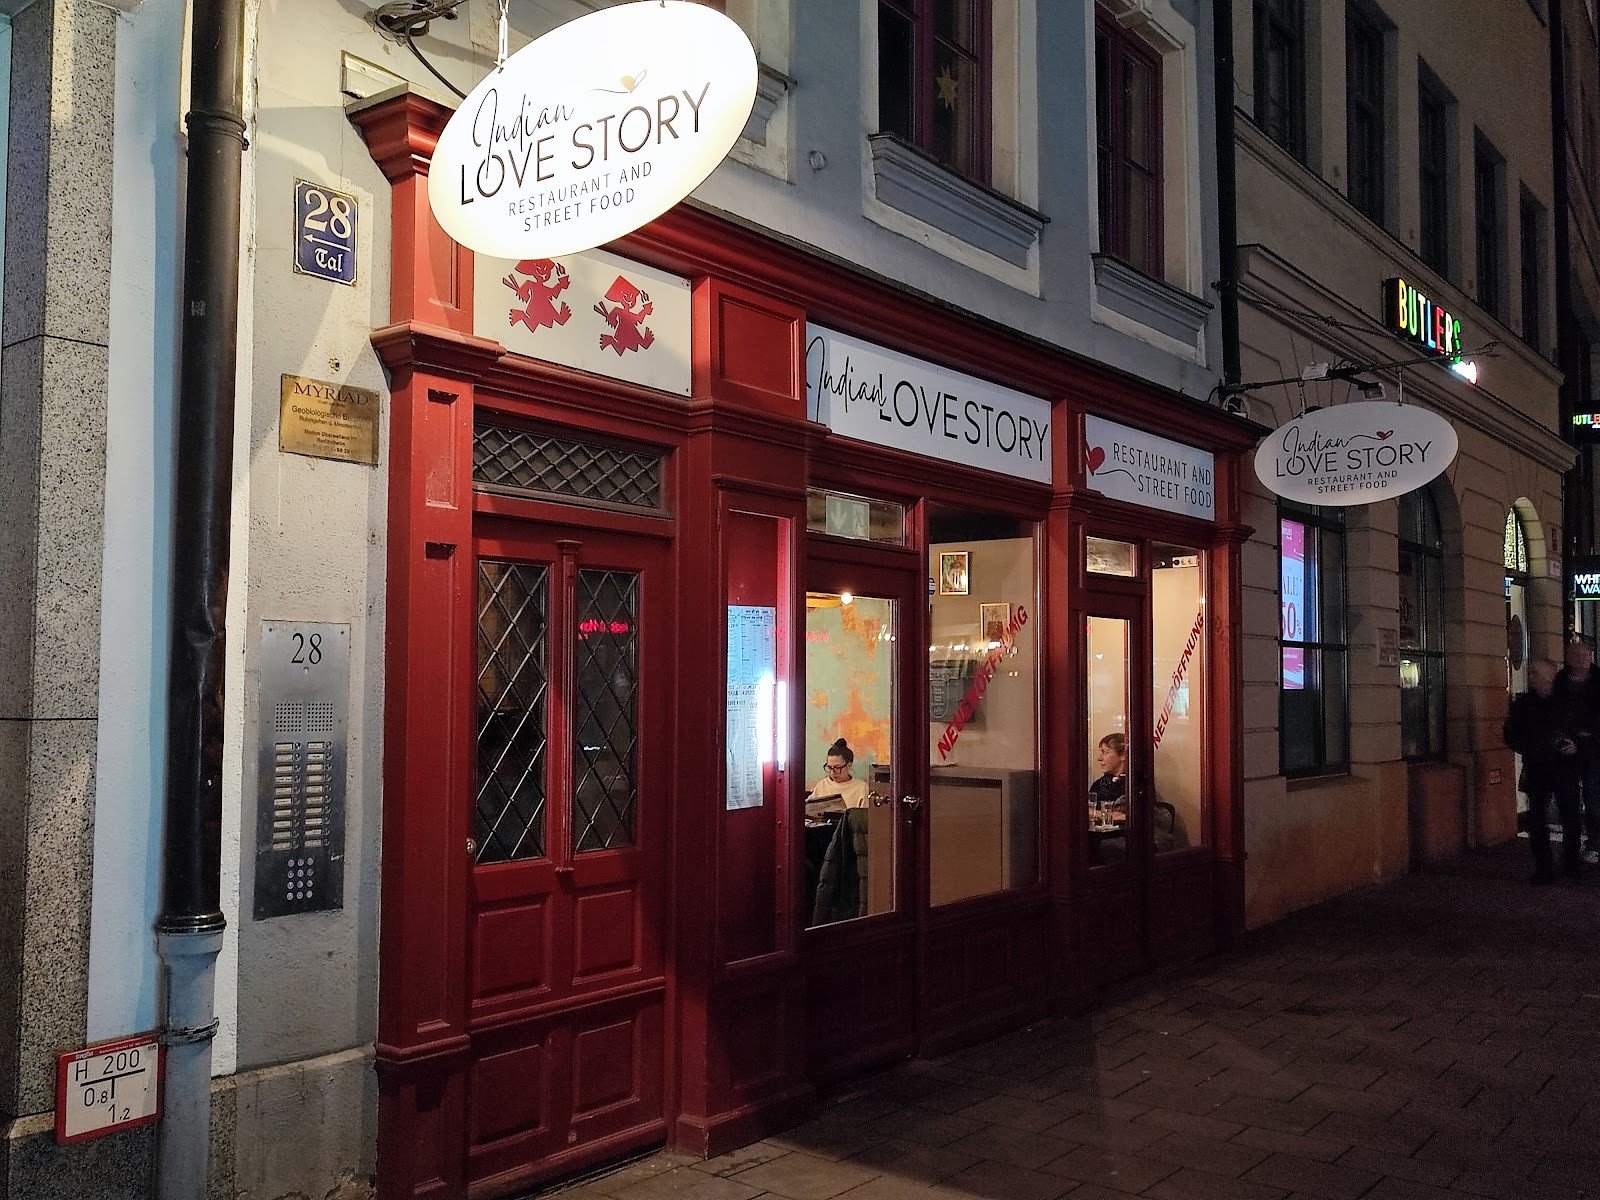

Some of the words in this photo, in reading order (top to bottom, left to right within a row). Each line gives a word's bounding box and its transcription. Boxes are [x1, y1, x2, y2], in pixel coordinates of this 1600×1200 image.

[461, 135, 555, 206] LOVE
[572, 82, 711, 170] STORY
[472, 88, 574, 180] Indian
[508, 173, 611, 217] RESTAURANT
[619, 161, 652, 184] AND
[524, 202, 582, 233] STREET
[590, 187, 635, 213] FOOD
[303, 188, 352, 239] 28
[314, 247, 343, 273] Tal
[1398, 278, 1461, 364] BUTLERS
[293, 381, 369, 406] MYRIAD
[806, 336, 887, 423] Indian
[1573, 413, 1600, 426] UTLE
[1113, 442, 1187, 479] RESTAURANT
[1191, 465, 1211, 486] AND
[1276, 451, 1338, 478] LOVE
[1347, 440, 1433, 470] STORY
[1282, 425, 1350, 468] Indian
[1138, 474, 1180, 500] STREET
[1184, 486, 1212, 508] FOOD
[1307, 472, 1373, 486] RESTAURANT
[1377, 470, 1398, 480] AND
[1318, 483, 1355, 494] STREET
[1359, 480, 1388, 490] FOOD
[291, 632, 323, 665] 28
[1152, 612, 1204, 750] NEUERÖFFNUNG
[75, 1061, 88, 1081] H
[103, 1049, 140, 1075] 200
